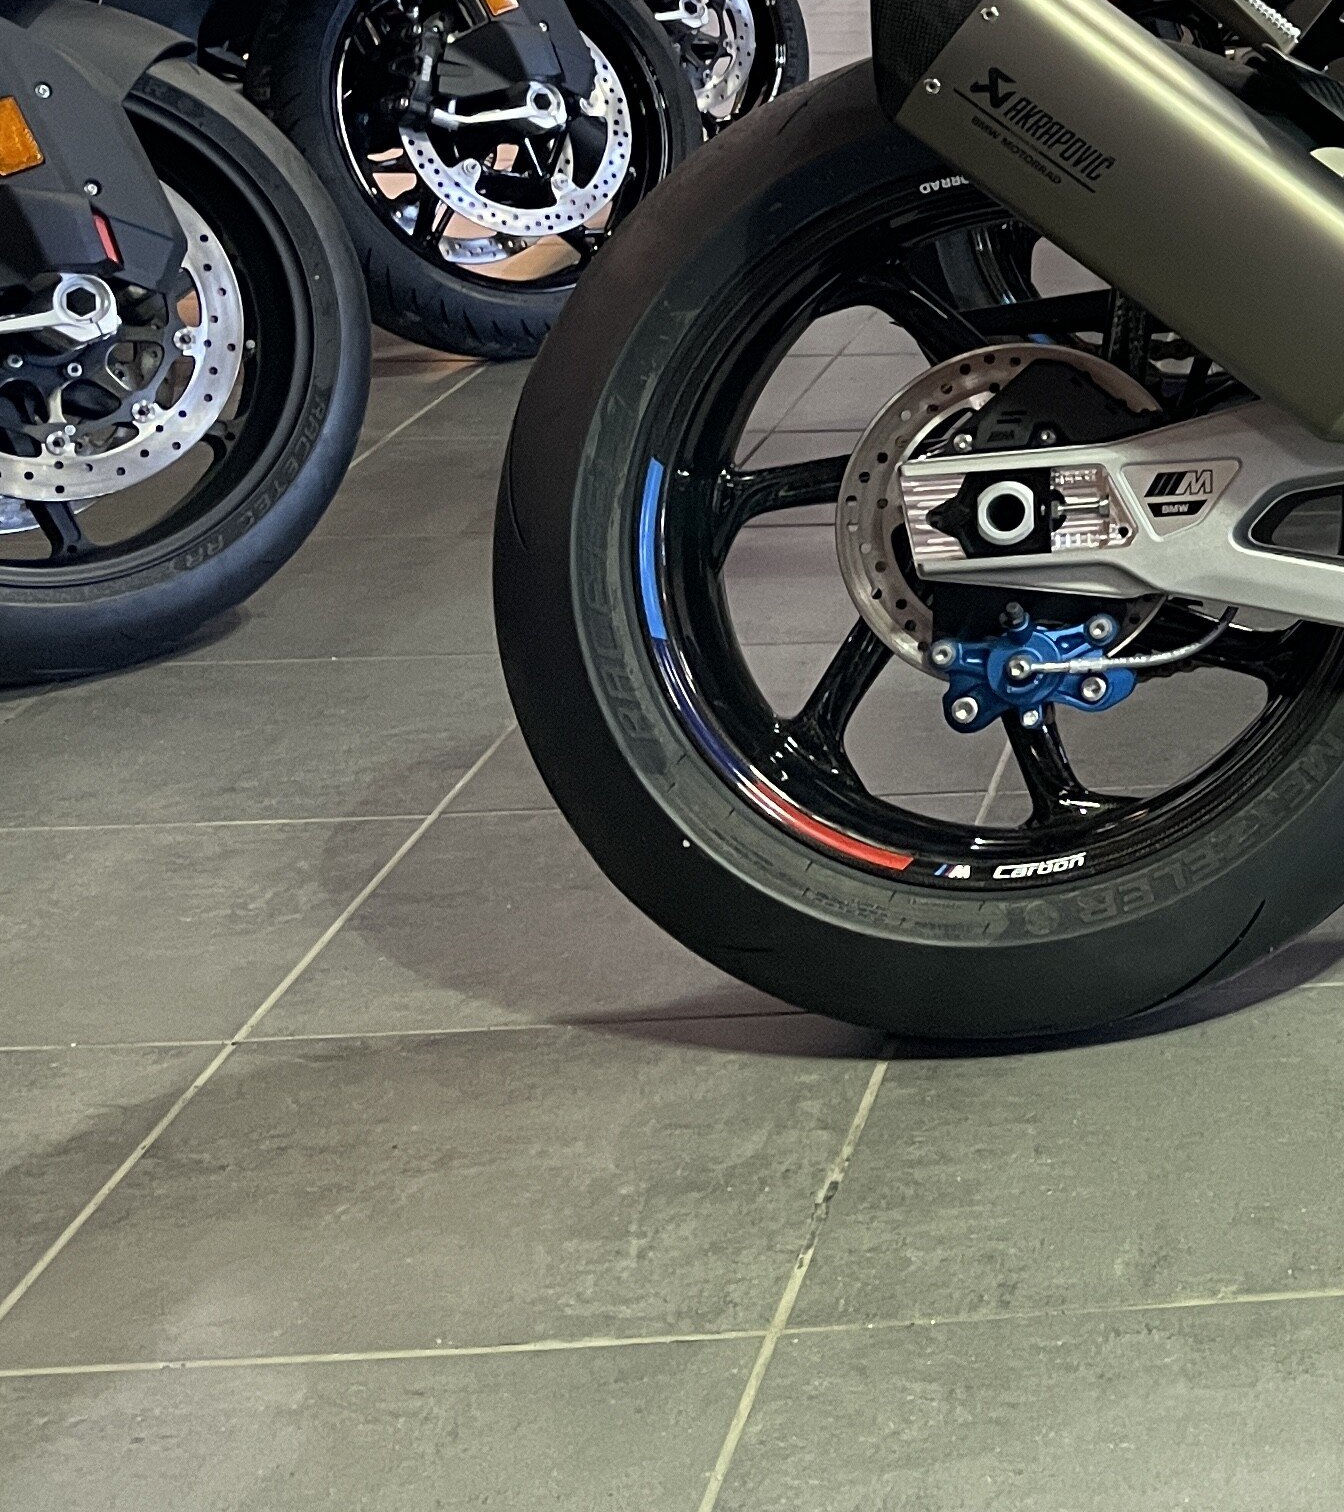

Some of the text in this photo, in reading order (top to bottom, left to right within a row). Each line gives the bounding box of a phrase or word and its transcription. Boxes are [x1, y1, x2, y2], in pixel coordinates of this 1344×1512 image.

[971, 114, 1062, 184] BMW MOTORRAD
[1161, 502, 1190, 515] BMW
[992, 851, 1087, 879] Carbon
